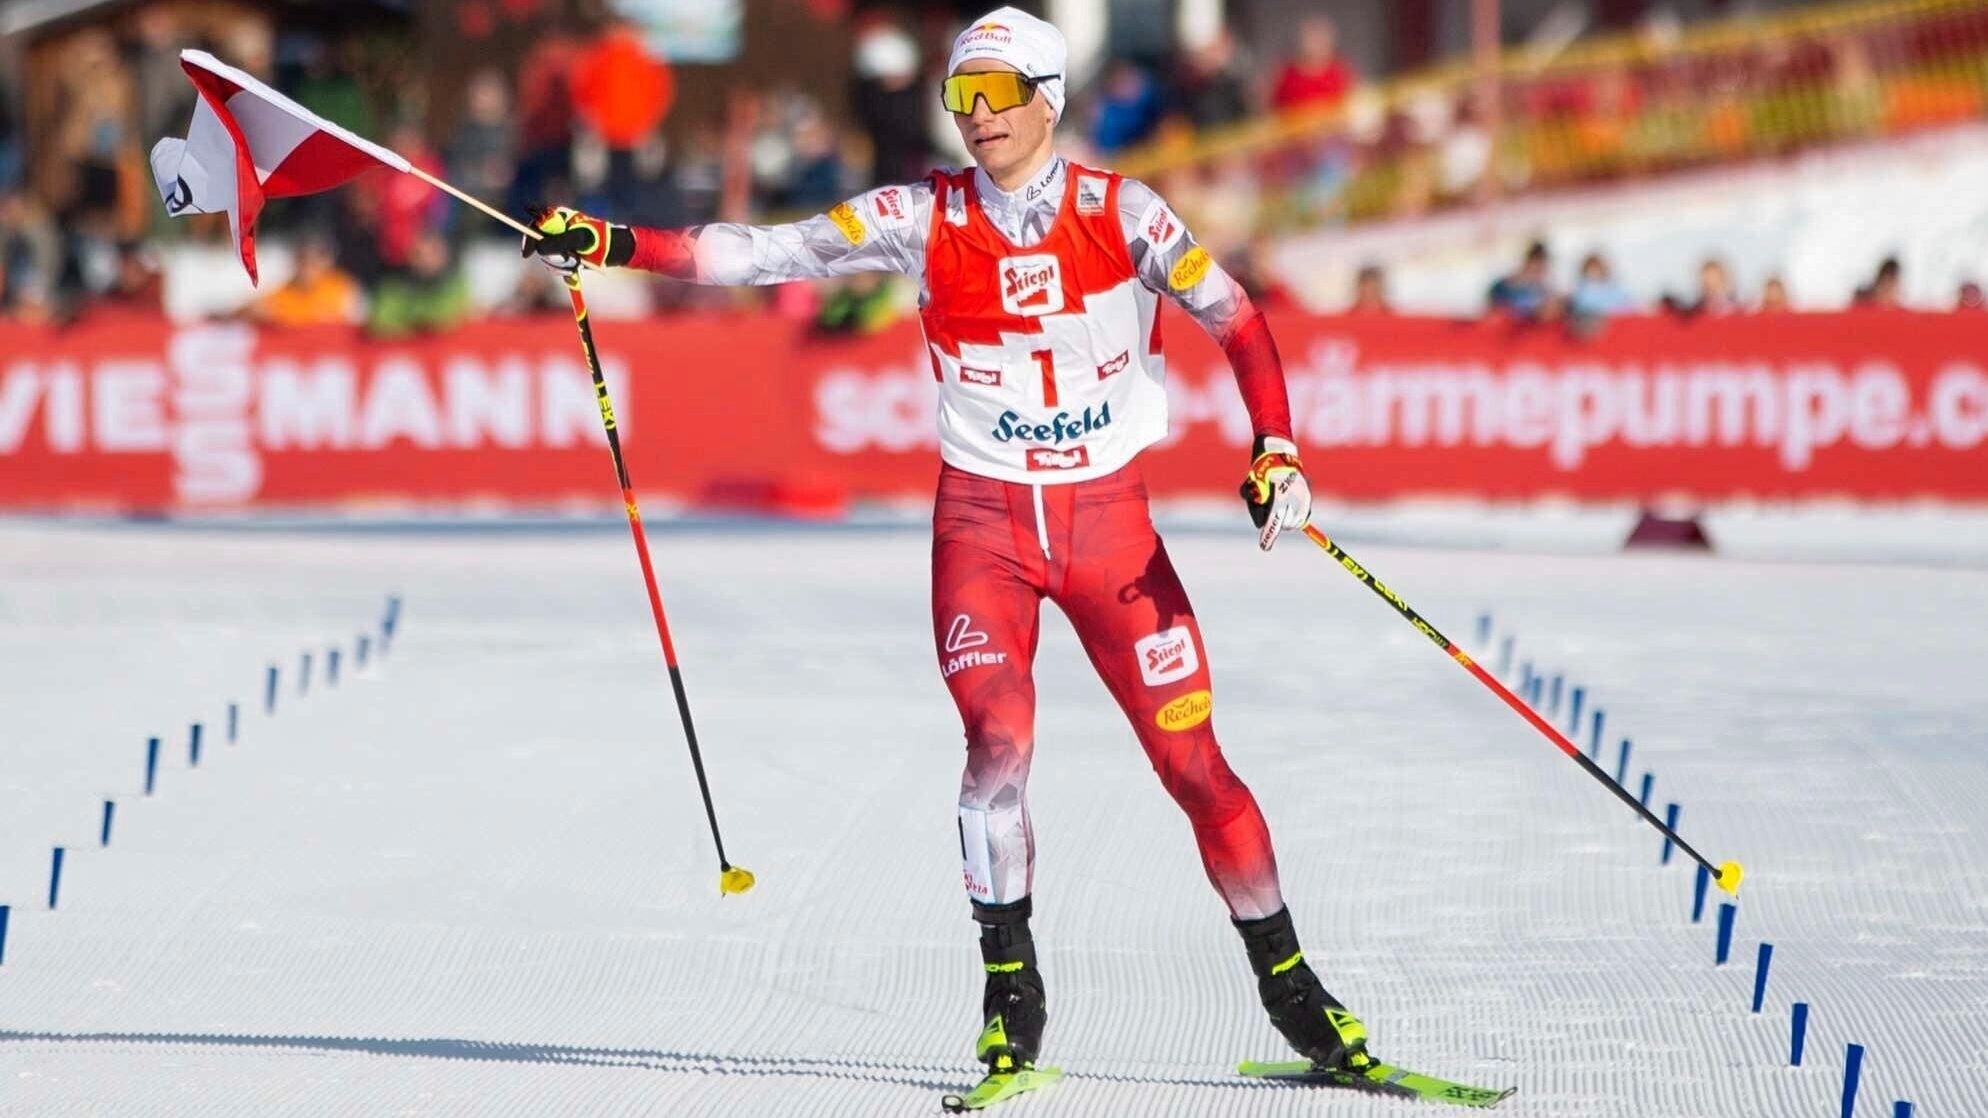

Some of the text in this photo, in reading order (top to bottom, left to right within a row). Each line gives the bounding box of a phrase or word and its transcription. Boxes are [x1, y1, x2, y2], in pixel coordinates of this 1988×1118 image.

[1004, 264, 1055, 299] Stiegl
[1031, 350, 1059, 408] 1
[992, 400, 1112, 445] Seefeld
